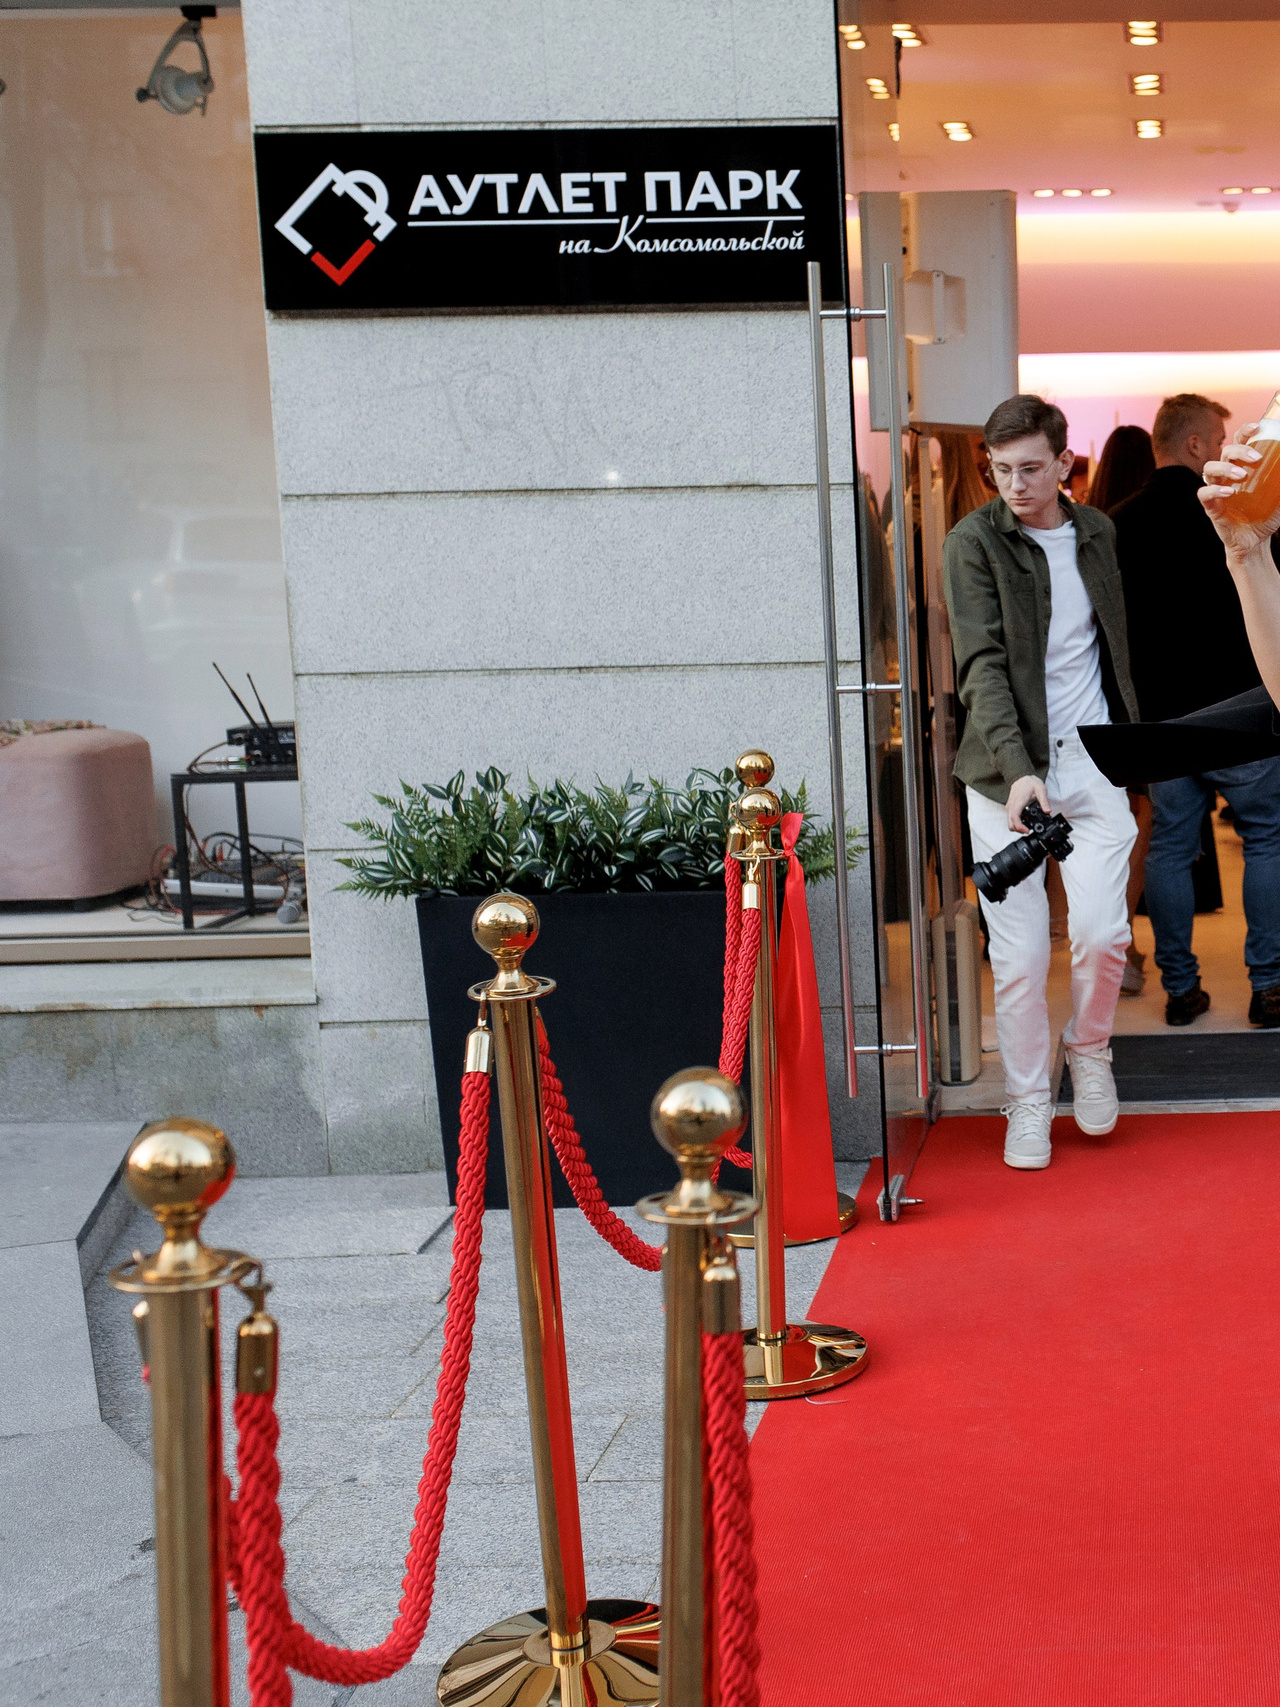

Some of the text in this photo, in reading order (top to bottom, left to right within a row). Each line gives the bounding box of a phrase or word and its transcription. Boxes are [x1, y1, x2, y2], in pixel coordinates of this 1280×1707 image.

[408, 169, 803, 216] АУТЛЕТ ПАРК
[558, 214, 805, 254] на Комсомольской
